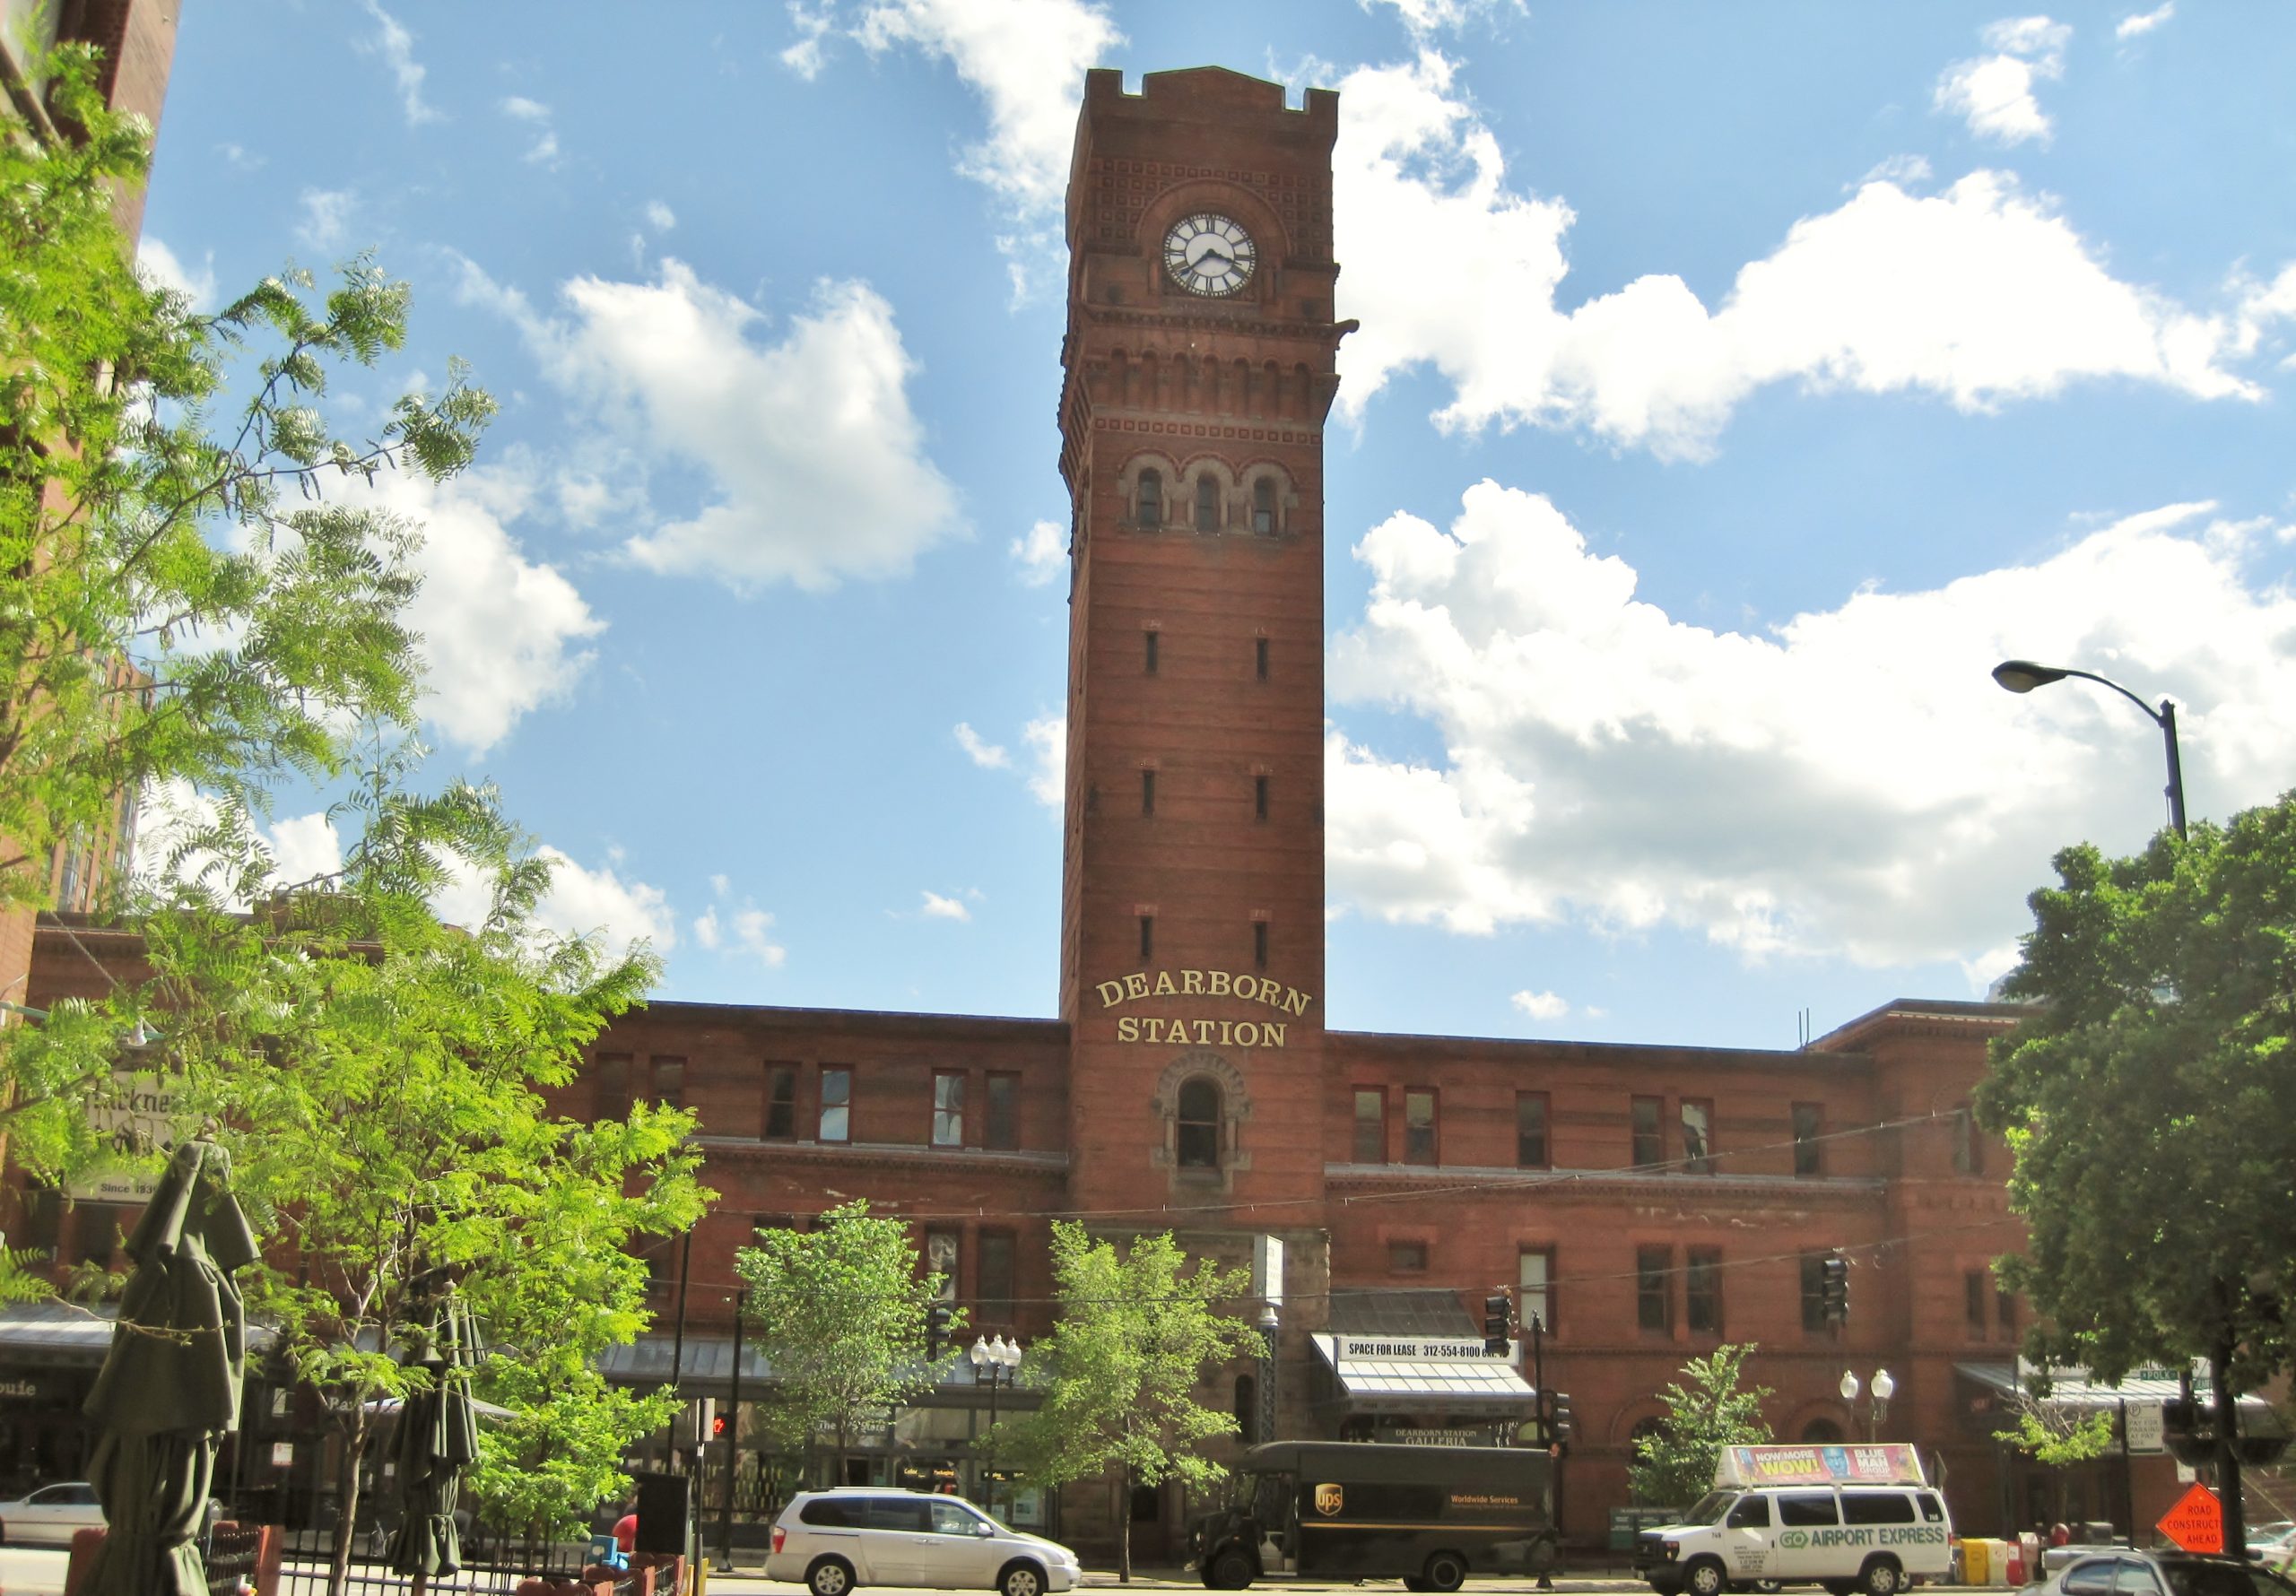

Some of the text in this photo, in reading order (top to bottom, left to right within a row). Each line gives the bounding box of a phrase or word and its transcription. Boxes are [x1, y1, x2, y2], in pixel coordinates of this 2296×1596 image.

[1096, 969, 1312, 1017] DEARBORN
[1118, 1017, 1288, 1047] STATION
[100, 1183, 130, 1194] Since
[1349, 1343, 1374, 1355] SPACE
[1376, 1344, 1392, 1356] FOR
[1394, 1344, 1416, 1356] LEASE
[1423, 1345, 1480, 1357] 312-554-8100
[2148, 1371, 2170, 1380] POLK
[1405, 1436, 1467, 1446] GALLERIA
[1755, 1450, 1816, 1462] NOW MORE
[1854, 1449, 1885, 1458] BLUE
[1759, 1459, 1822, 1475] WOW!
[1857, 1457, 1890, 1468] MAN
[1859, 1466, 1891, 1474] GROUP
[1318, 1493, 1341, 1511] ups
[1450, 1495, 1518, 1505] Worldwide Services
[2188, 1505, 2212, 1515] ROAD
[2167, 1520, 2219, 1531] CONSTRUCT
[1812, 1529, 1874, 1547] AIRPORT
[1879, 1526, 1944, 1544] EXPRESS
[2187, 1534, 2217, 1544] AHEAD
